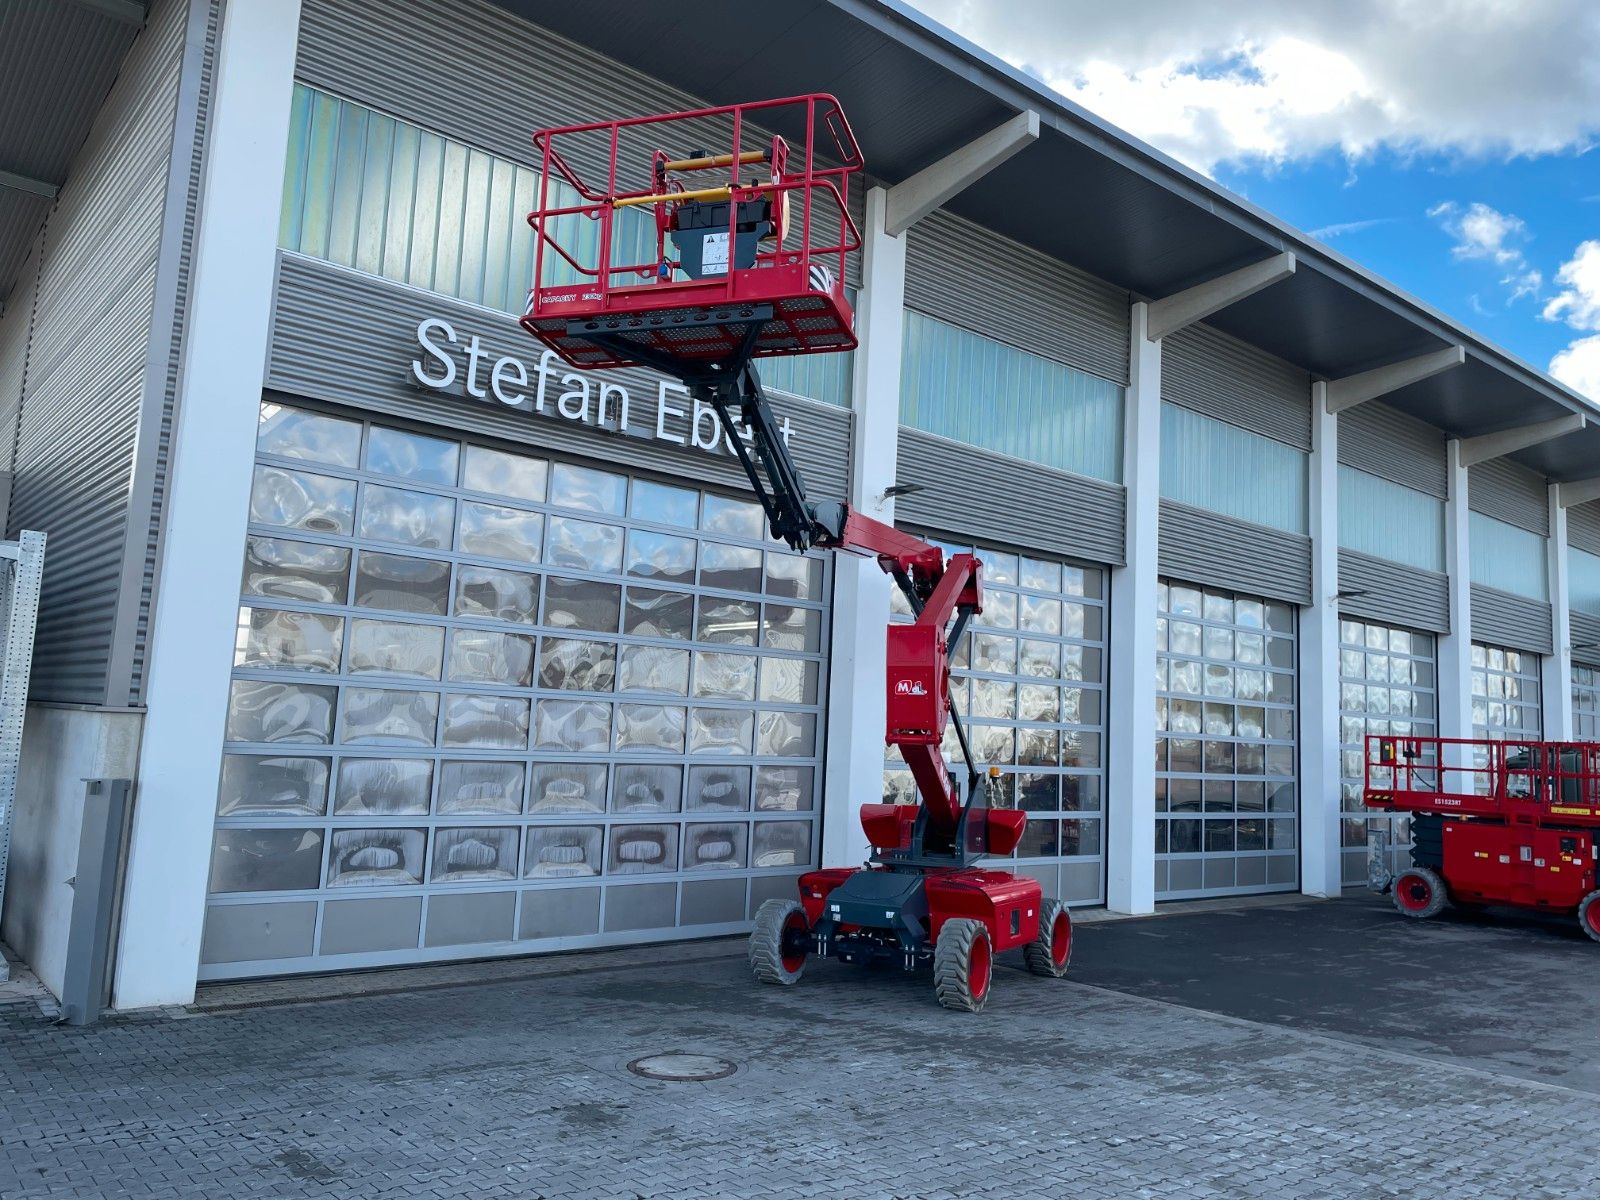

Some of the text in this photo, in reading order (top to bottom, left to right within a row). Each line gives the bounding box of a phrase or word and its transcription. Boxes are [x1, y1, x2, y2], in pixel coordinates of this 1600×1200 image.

[541, 294, 577, 304] CAPACITY
[412, 318, 796, 457] Stefan Ebet
